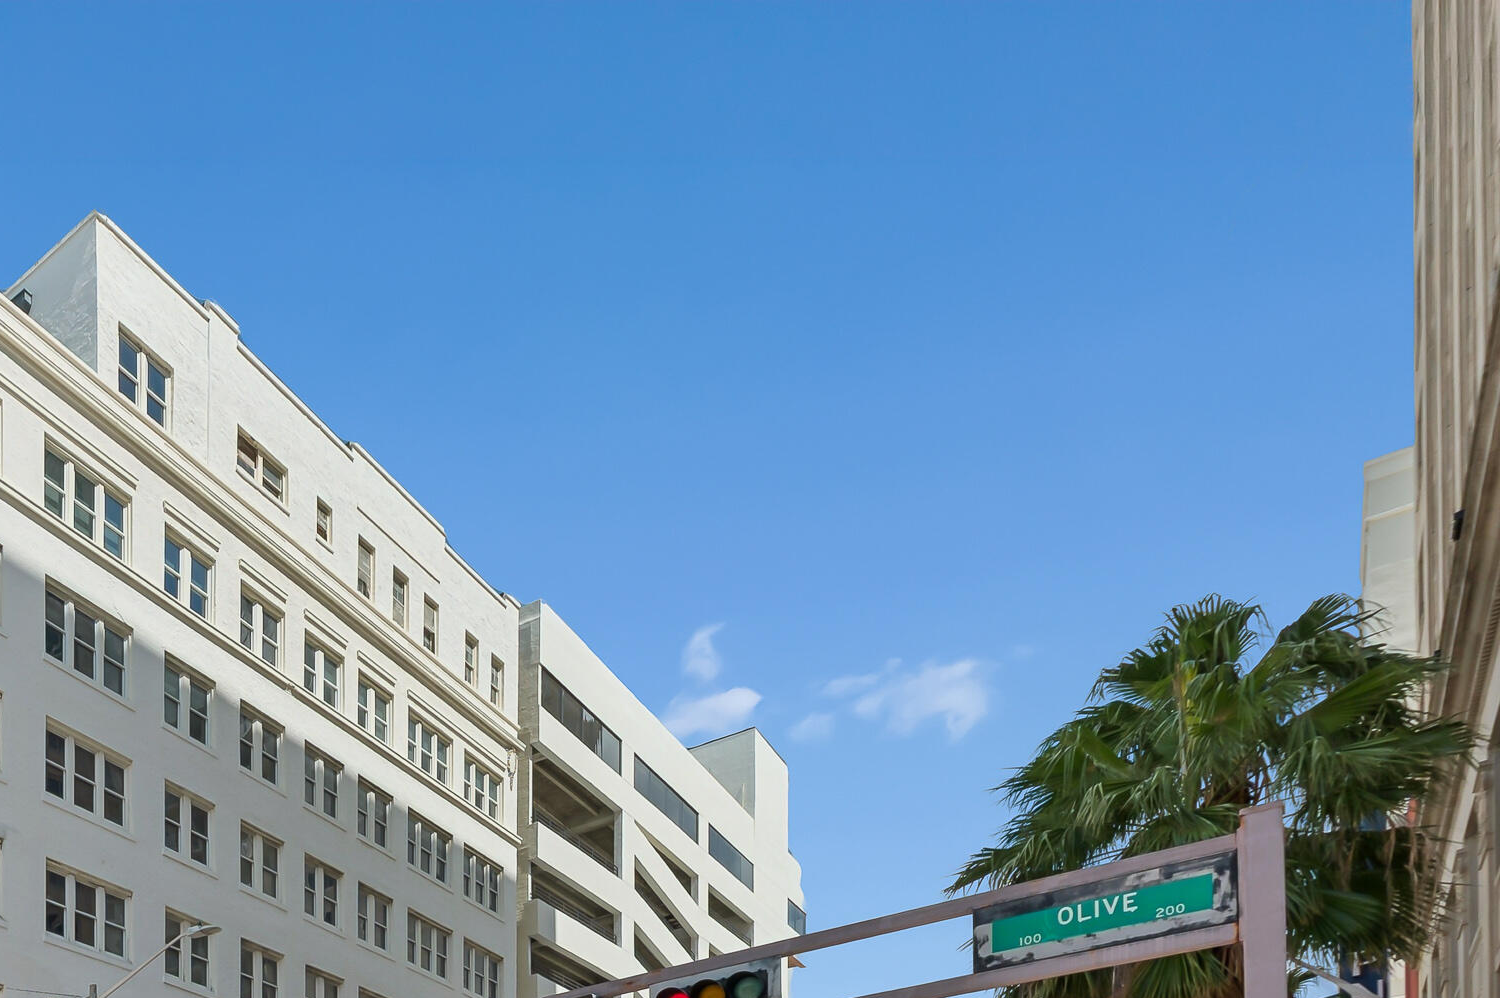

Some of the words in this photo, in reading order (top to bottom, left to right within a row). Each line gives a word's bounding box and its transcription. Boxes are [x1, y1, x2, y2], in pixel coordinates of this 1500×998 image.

[1057, 891, 1138, 926] OLIVE
[1155, 903, 1186, 919] 200
[1019, 932, 1042, 947] 100
